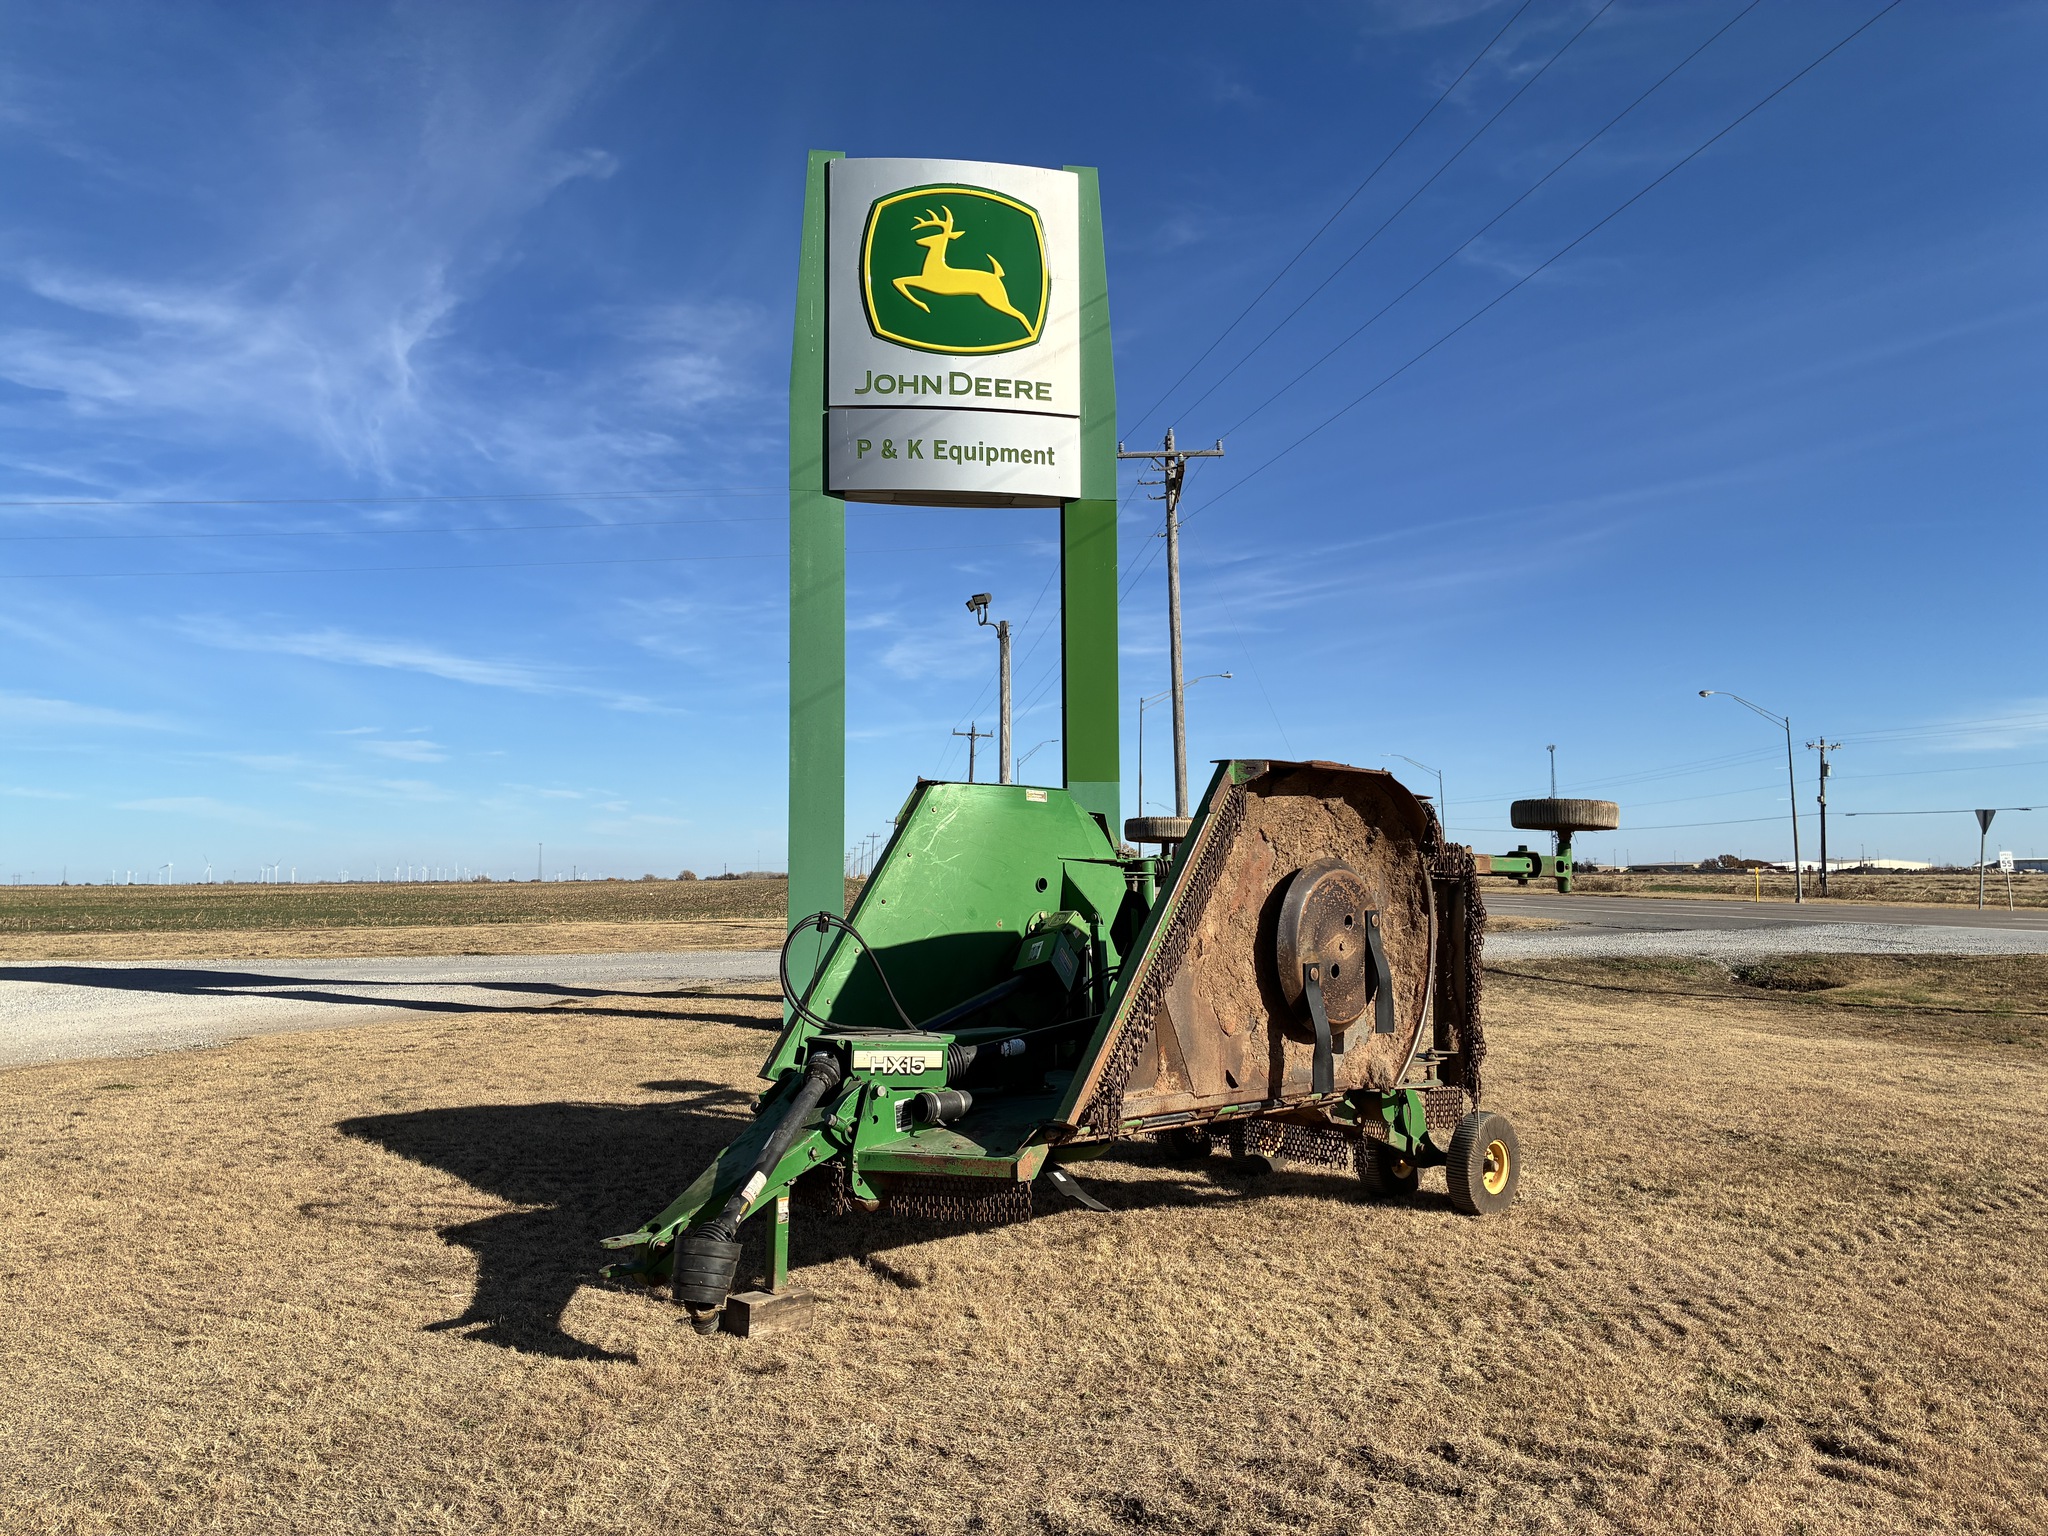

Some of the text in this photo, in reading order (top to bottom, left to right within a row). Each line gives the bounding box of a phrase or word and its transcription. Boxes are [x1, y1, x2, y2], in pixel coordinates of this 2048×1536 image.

[854, 370, 1053, 401] JOHN DEERE
[856, 439, 1055, 466] P & K Equipment
[870, 1056, 926, 1076] HX15
